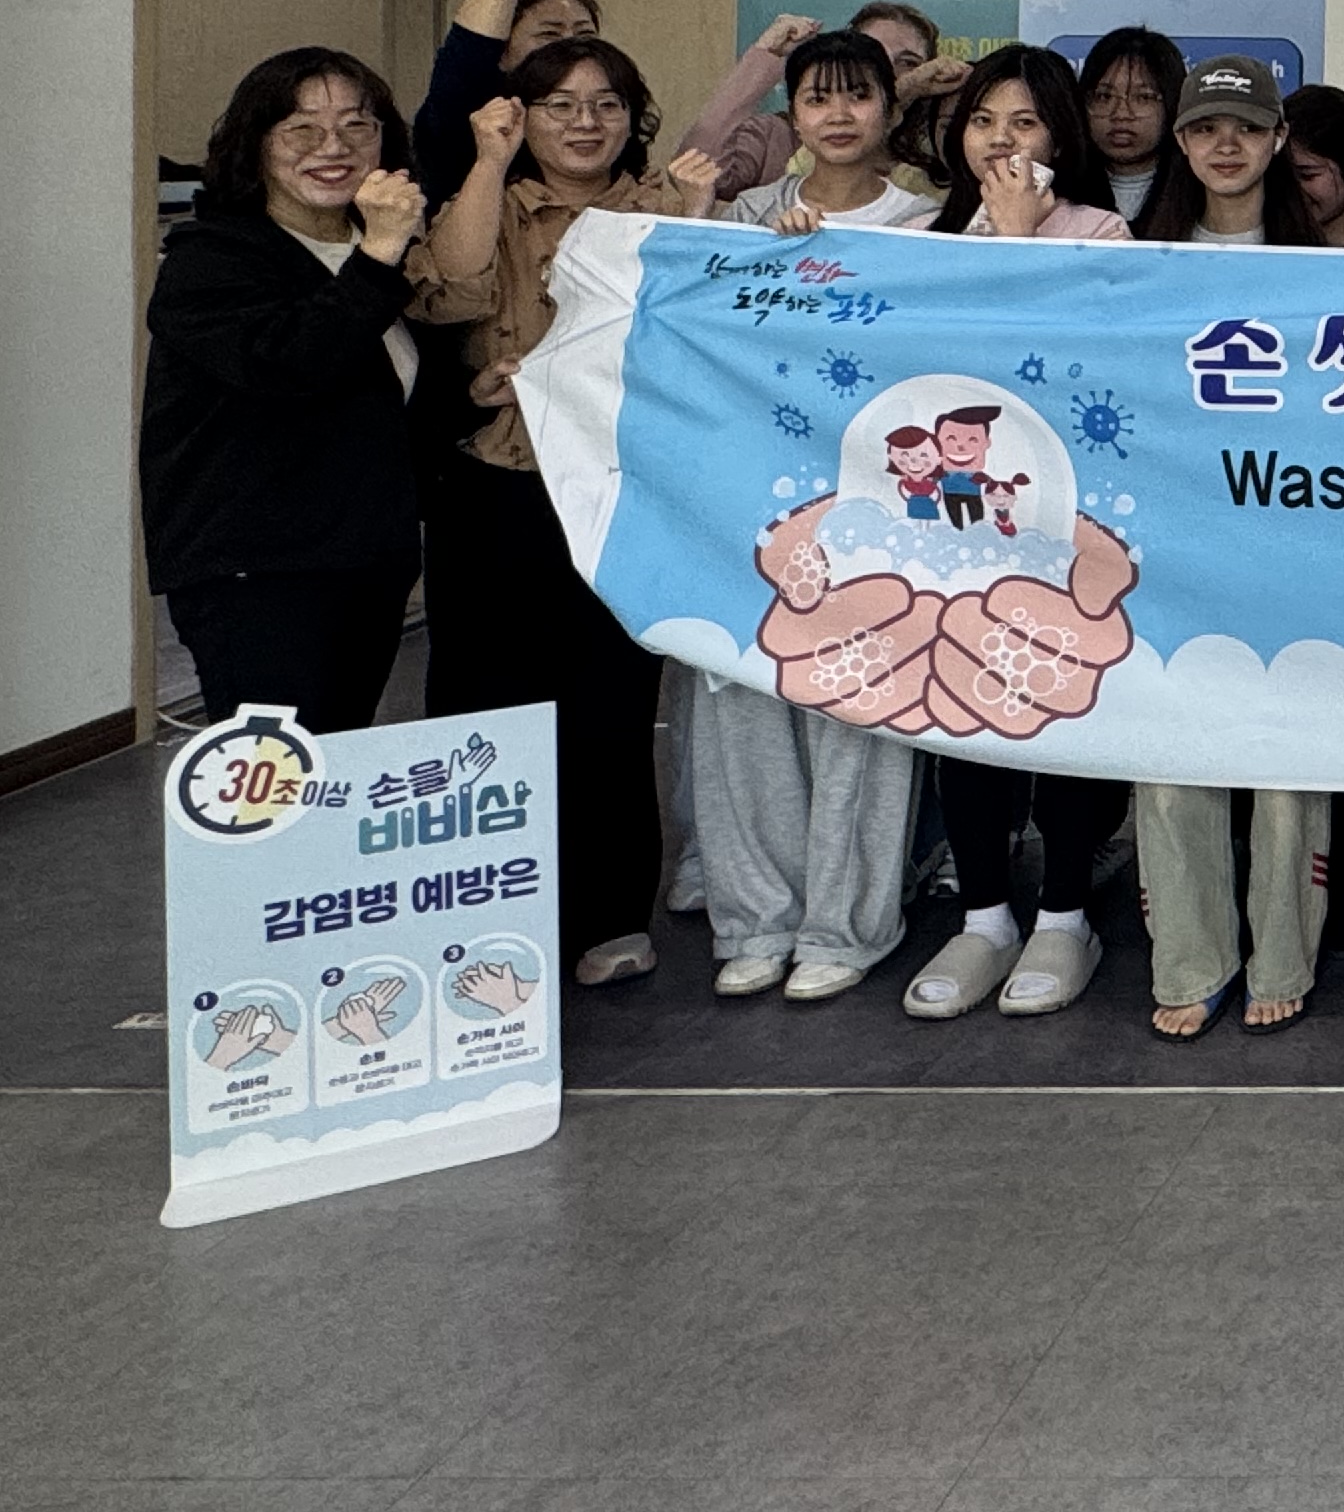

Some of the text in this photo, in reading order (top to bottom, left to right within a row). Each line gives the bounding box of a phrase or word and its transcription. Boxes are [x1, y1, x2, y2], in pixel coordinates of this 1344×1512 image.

[1190, 317, 1283, 405] 손
[367, 757, 450, 809] 손을
[263, 856, 540, 944] 감염병 예방은
